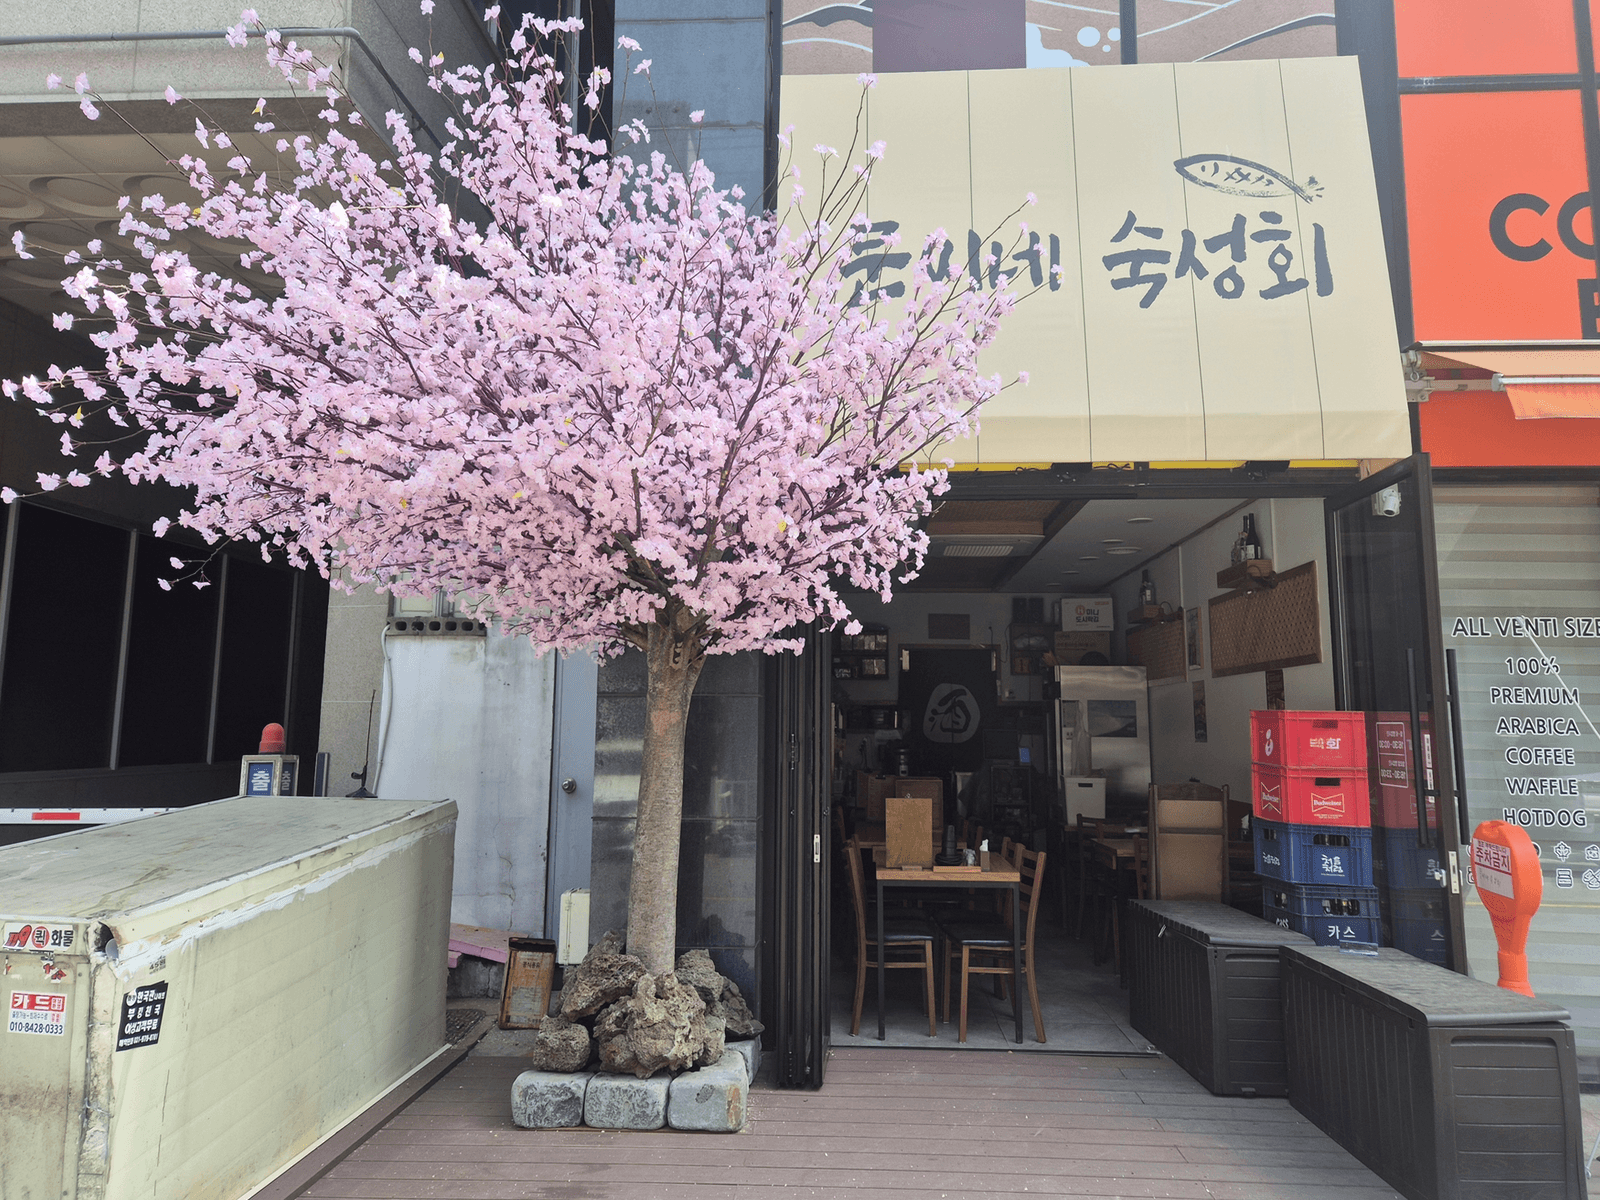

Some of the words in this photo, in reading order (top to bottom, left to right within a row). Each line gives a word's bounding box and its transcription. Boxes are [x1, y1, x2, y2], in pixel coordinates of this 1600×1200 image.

[1101, 210, 1334, 308] 숙성회
[1452, 617, 1491, 637] ALL
[1494, 617, 1559, 637] VENTI
[1505, 657, 1559, 674] 100%
[1491, 688, 1579, 705] PREMIUM
[1496, 718, 1580, 735] ARABICA
[1505, 748, 1575, 765] COFFEE
[1506, 778, 1578, 795] WAFFLE
[1503, 809, 1586, 827] HOTDOG
[1476, 847, 1510, 872] 주차금지
[51, 930, 74, 947] 화물
[1328, 925, 1356, 939] 카스
[13, 994, 50, 1010] 카드
